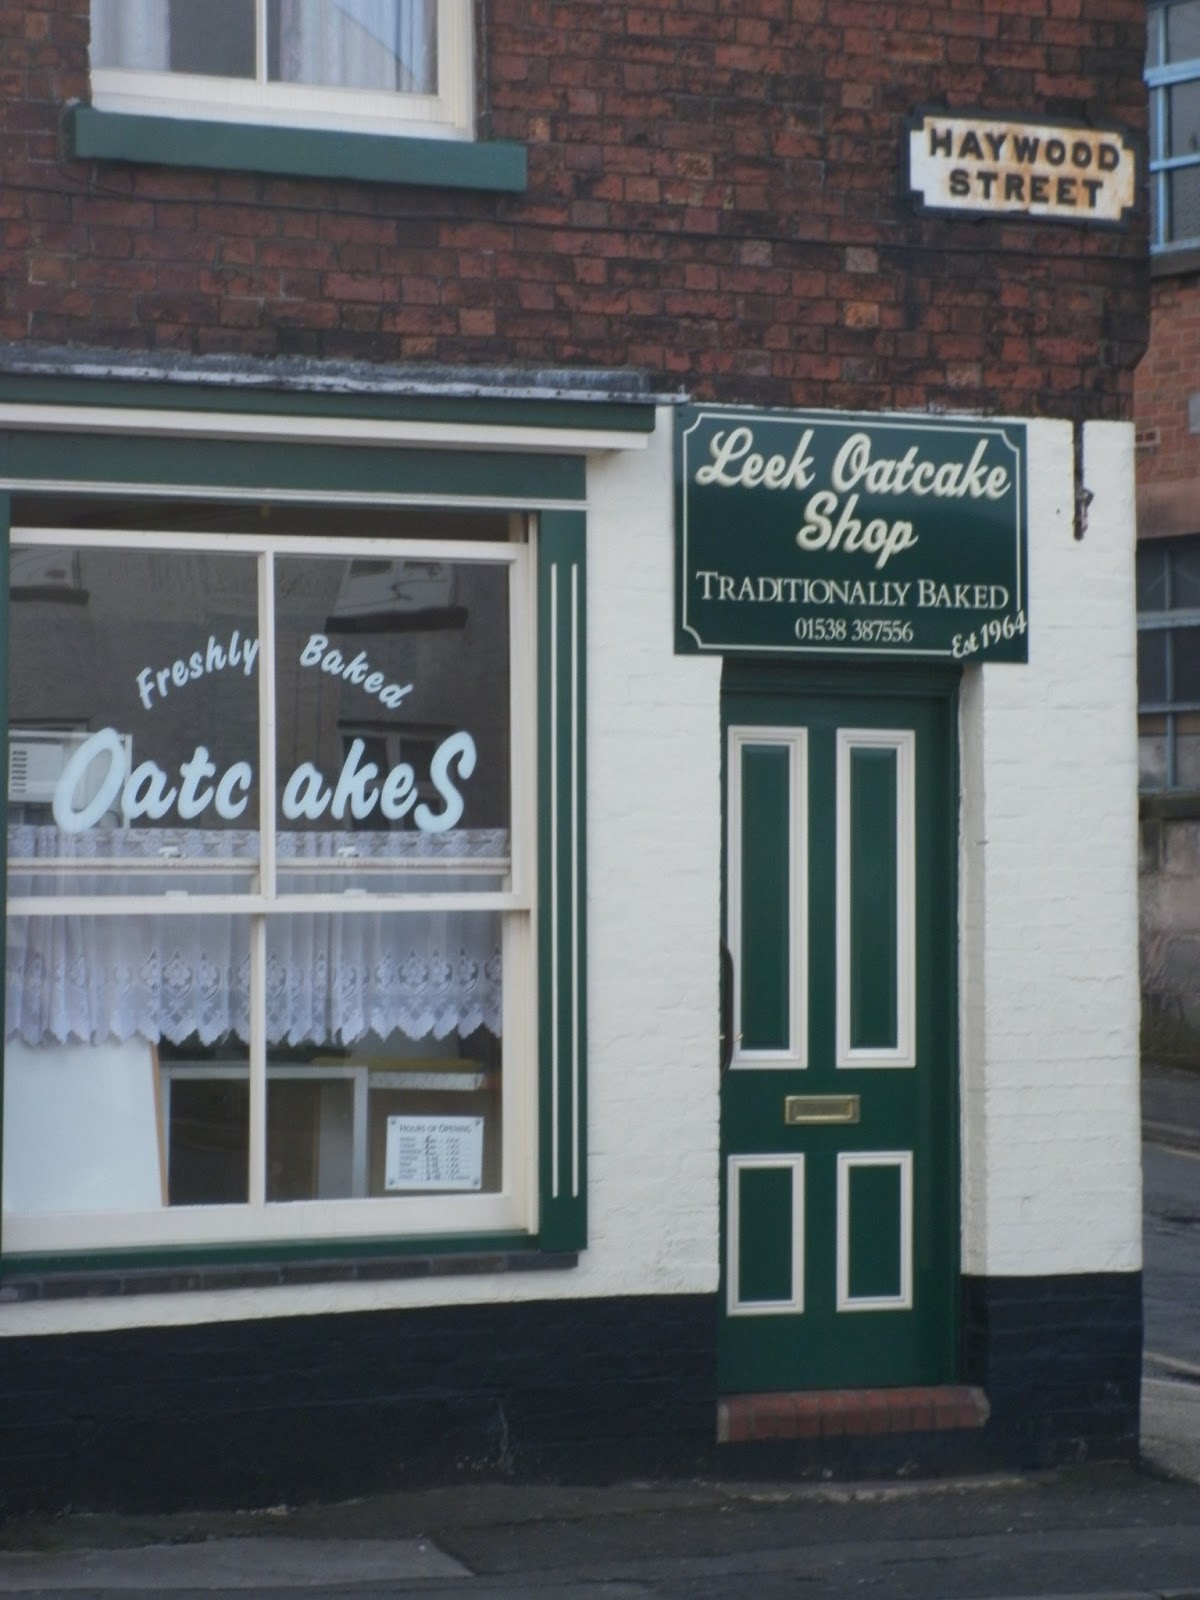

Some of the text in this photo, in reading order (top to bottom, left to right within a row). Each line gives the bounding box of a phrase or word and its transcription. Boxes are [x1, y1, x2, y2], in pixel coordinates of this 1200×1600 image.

[929, 127, 1120, 172] HAYWOOD
[949, 168, 1104, 208] STREET
[695, 426, 1012, 500] Leek Oatcake
[795, 490, 919, 570] Shop
[695, 571, 1010, 610] TRADITIONALLY BAKED
[794, 616, 914, 643] 01538 387556
[951, 609, 1028, 659] Est 1964
[136, 630, 414, 710] Freshly Baked
